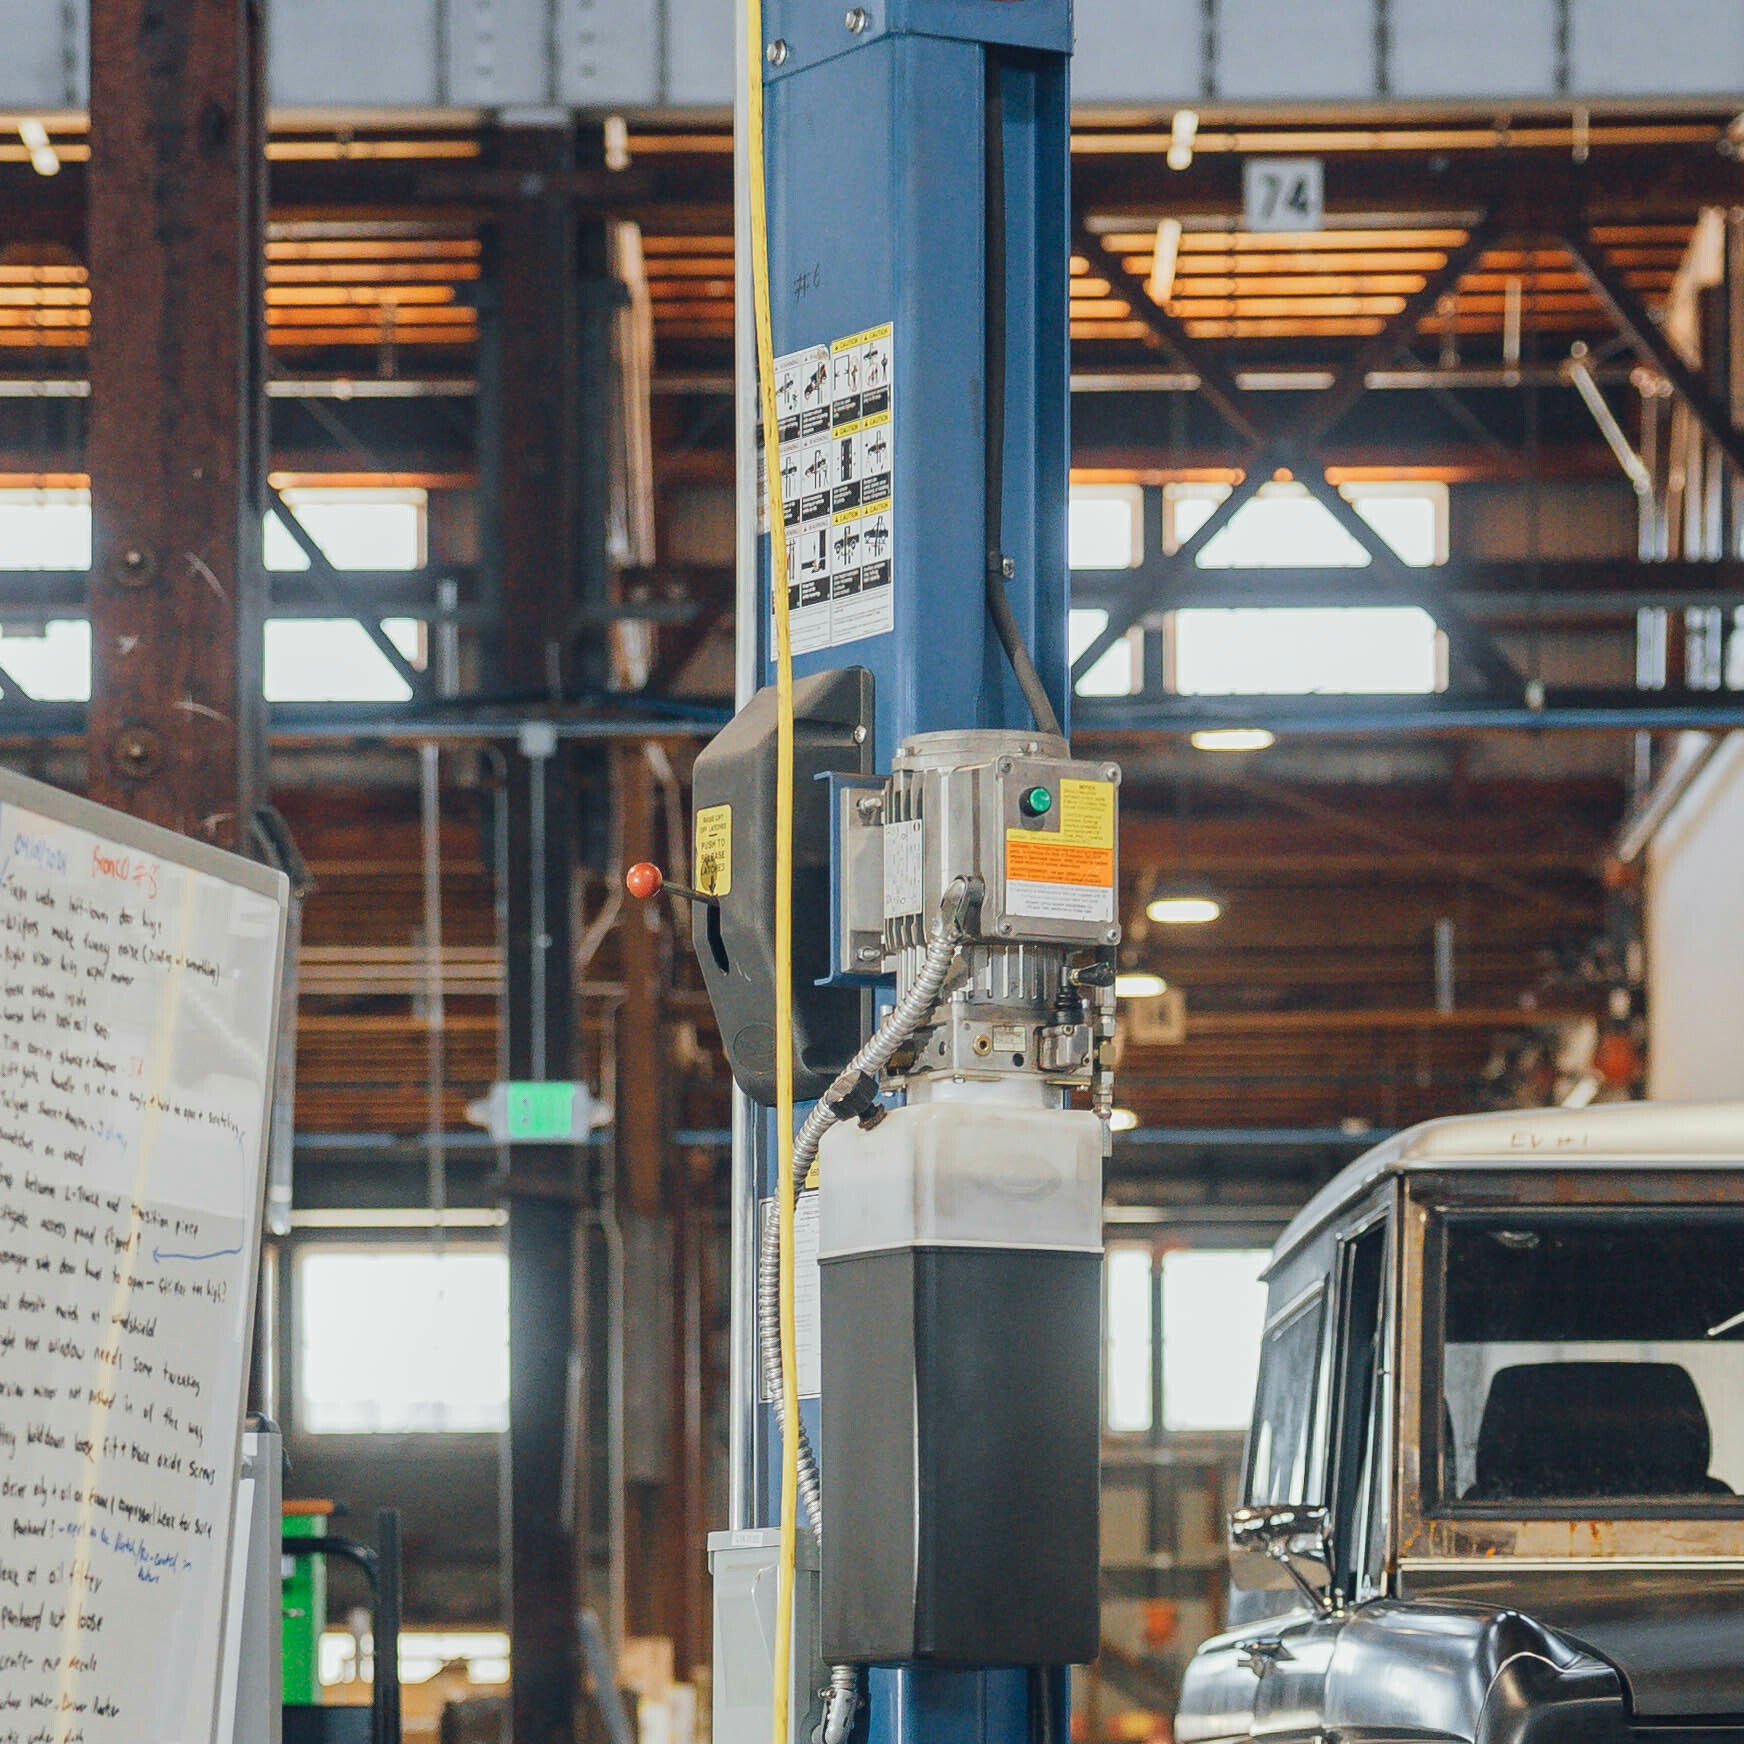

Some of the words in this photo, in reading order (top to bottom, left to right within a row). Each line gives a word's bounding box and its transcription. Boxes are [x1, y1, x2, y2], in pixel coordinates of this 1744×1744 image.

[1260, 173, 1310, 218] 74
[701, 840, 717, 850] PUSH
[718, 838, 726, 848] TO
